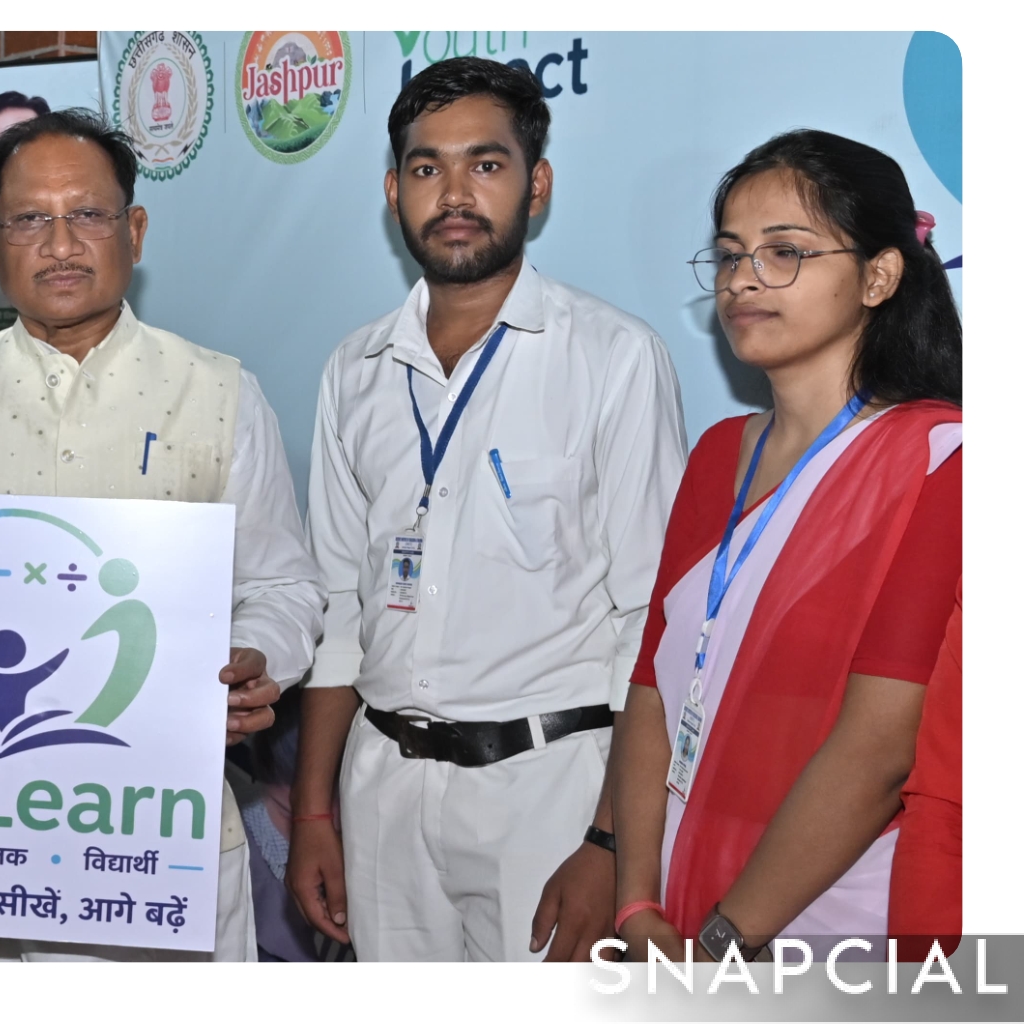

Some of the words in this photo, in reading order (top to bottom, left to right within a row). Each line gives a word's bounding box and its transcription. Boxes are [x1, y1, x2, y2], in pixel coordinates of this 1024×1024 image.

[243, 59, 343, 105] Jashpur
[82, 846, 160, 876] विद्यार्थी
[78, 891, 137, 924] आगे
